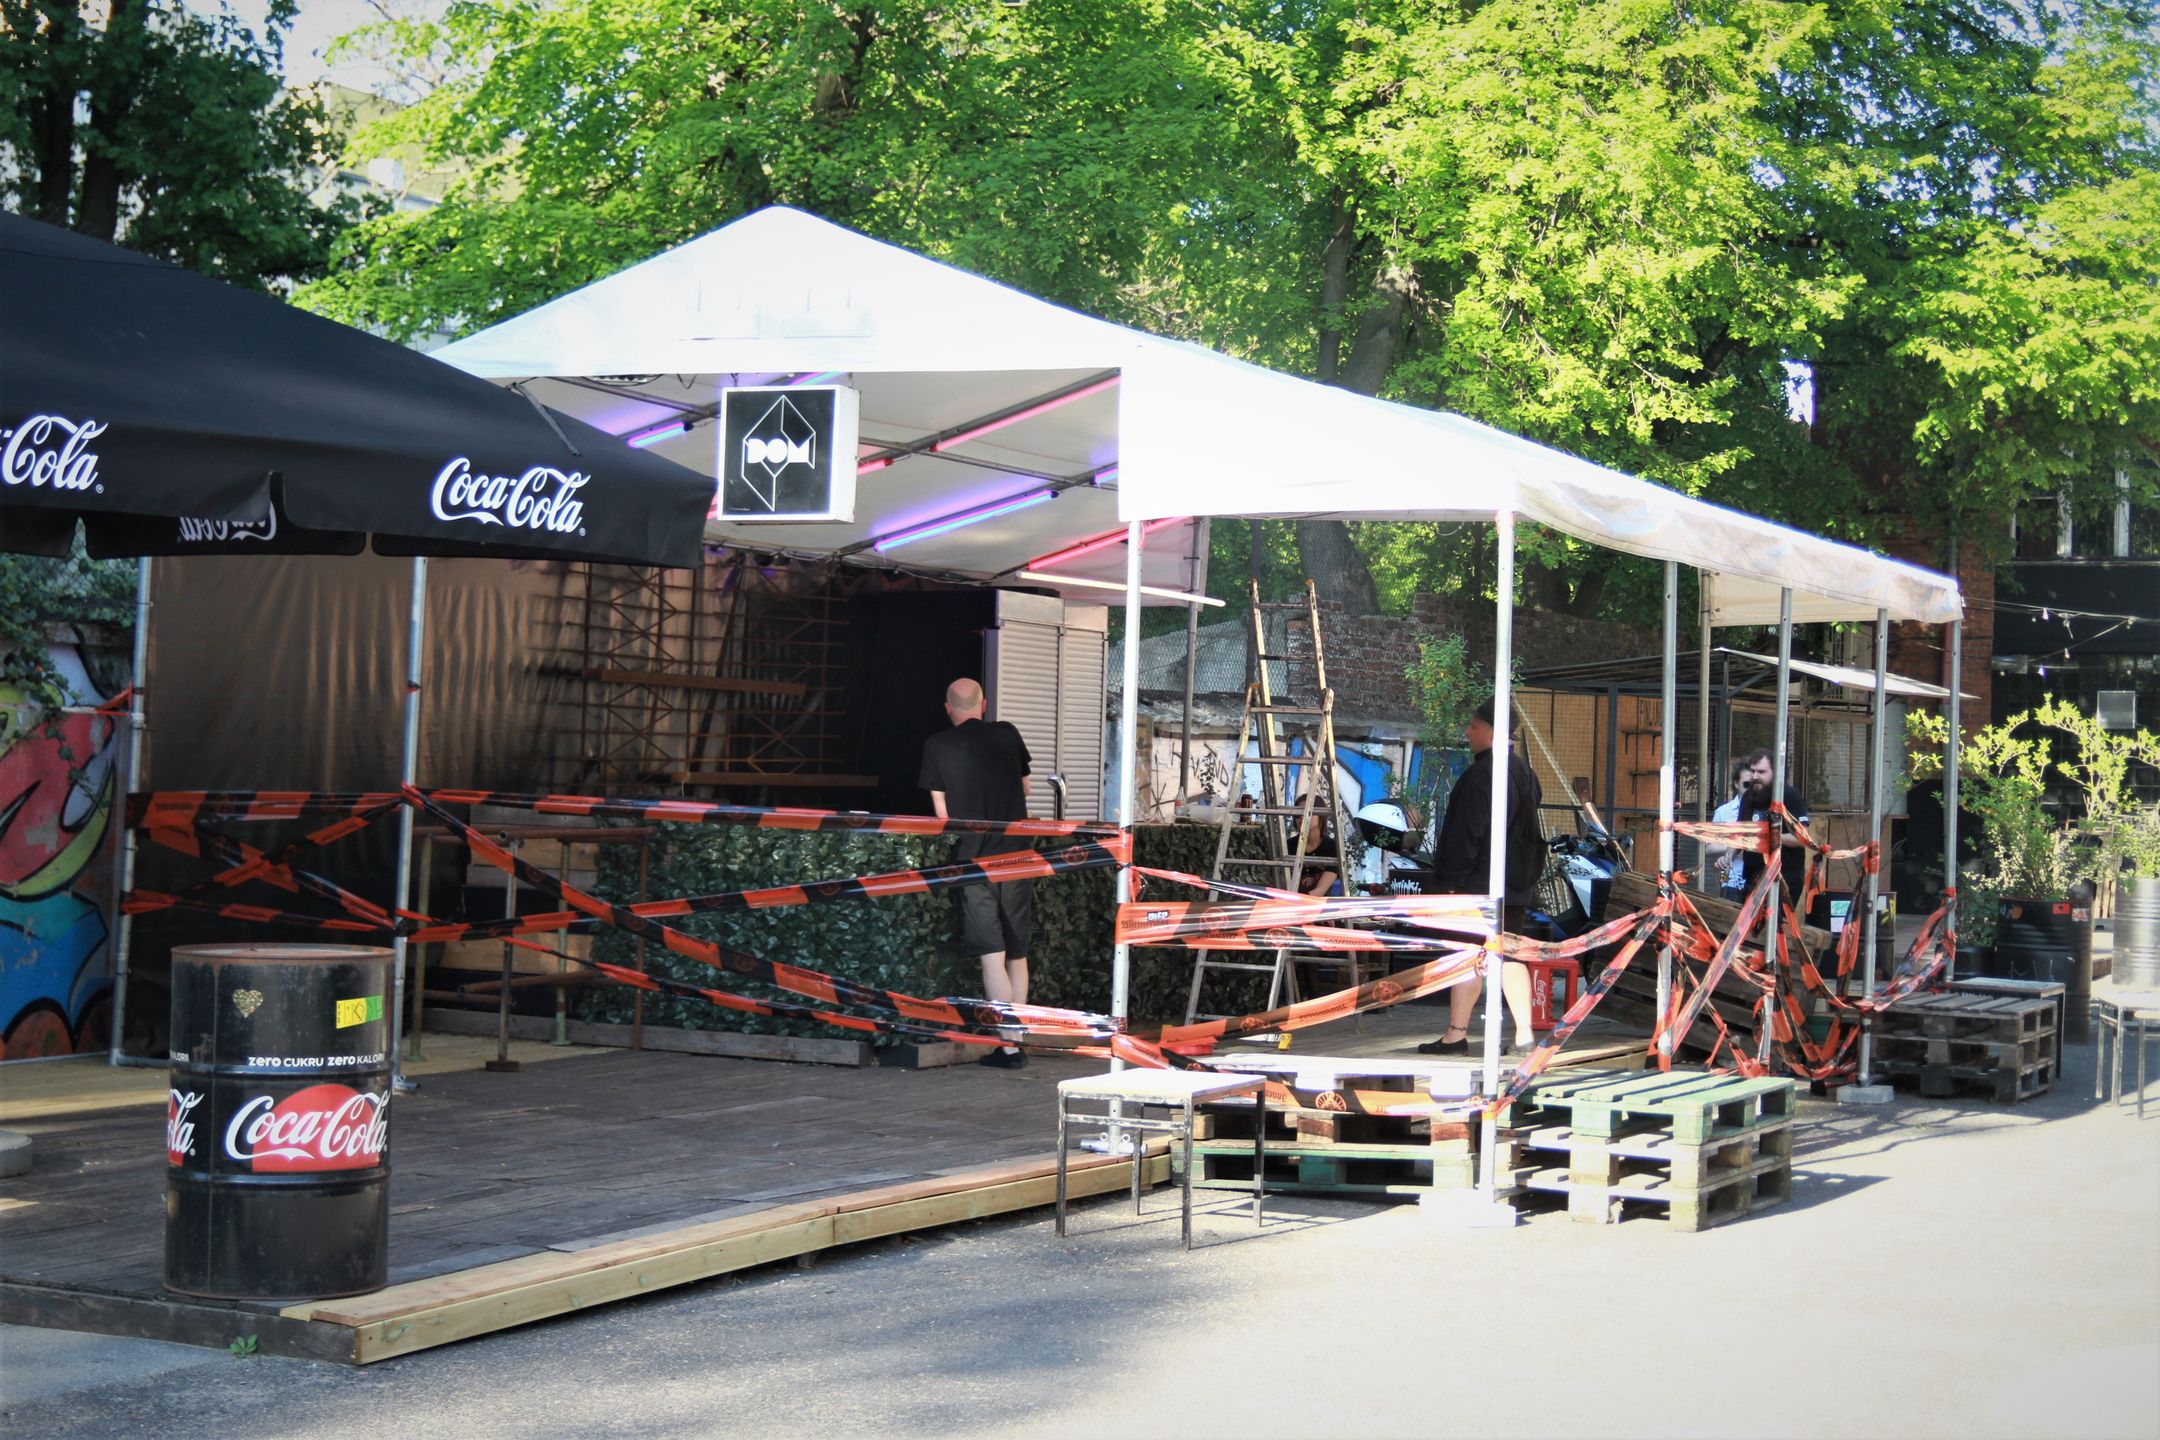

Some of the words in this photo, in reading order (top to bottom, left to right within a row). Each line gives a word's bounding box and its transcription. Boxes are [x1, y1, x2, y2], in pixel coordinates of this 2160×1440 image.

[0, 415, 109, 490] -Cola
[747, 438, 810, 463] DOM
[432, 457, 592, 533] Coca-Cola
[248, 1056, 281, 1067] zero
[284, 1056, 324, 1067] CUKRU
[327, 1055, 356, 1066] zero
[225, 1089, 390, 1161] Coca-Cola
